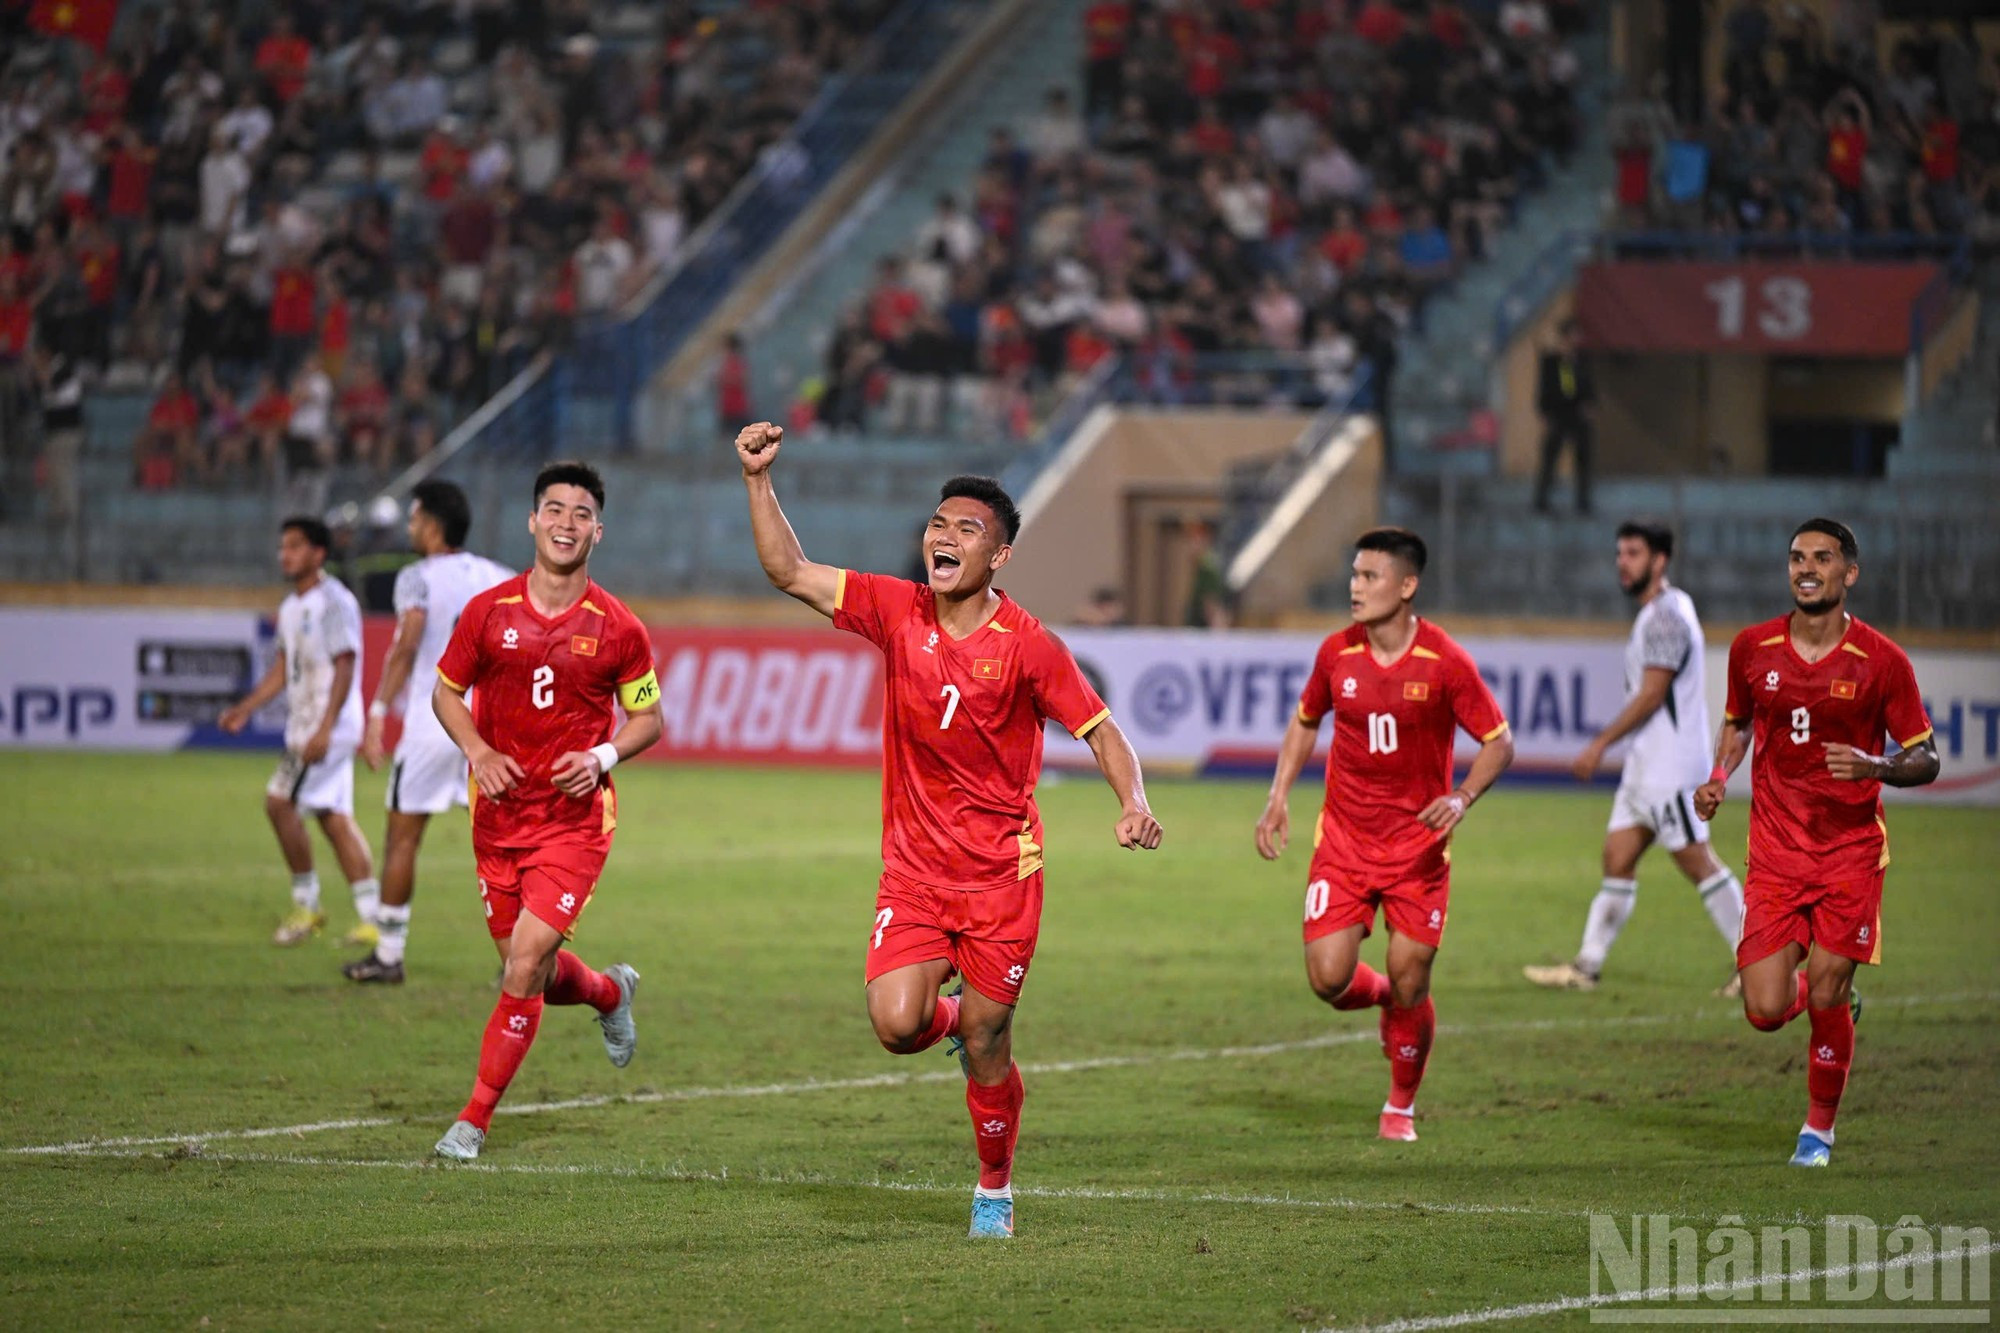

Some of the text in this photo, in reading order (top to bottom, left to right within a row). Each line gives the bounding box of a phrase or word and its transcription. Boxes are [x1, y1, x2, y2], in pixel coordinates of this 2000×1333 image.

[1704, 275, 1812, 340] 13
[531, 665, 554, 710] 2
[652, 646, 885, 751] ARBOL
[940, 684, 961, 730] 7
[1479, 666, 1606, 736] IAL
[1368, 711, 1398, 755] 10
[1790, 706, 1810, 745] 9
